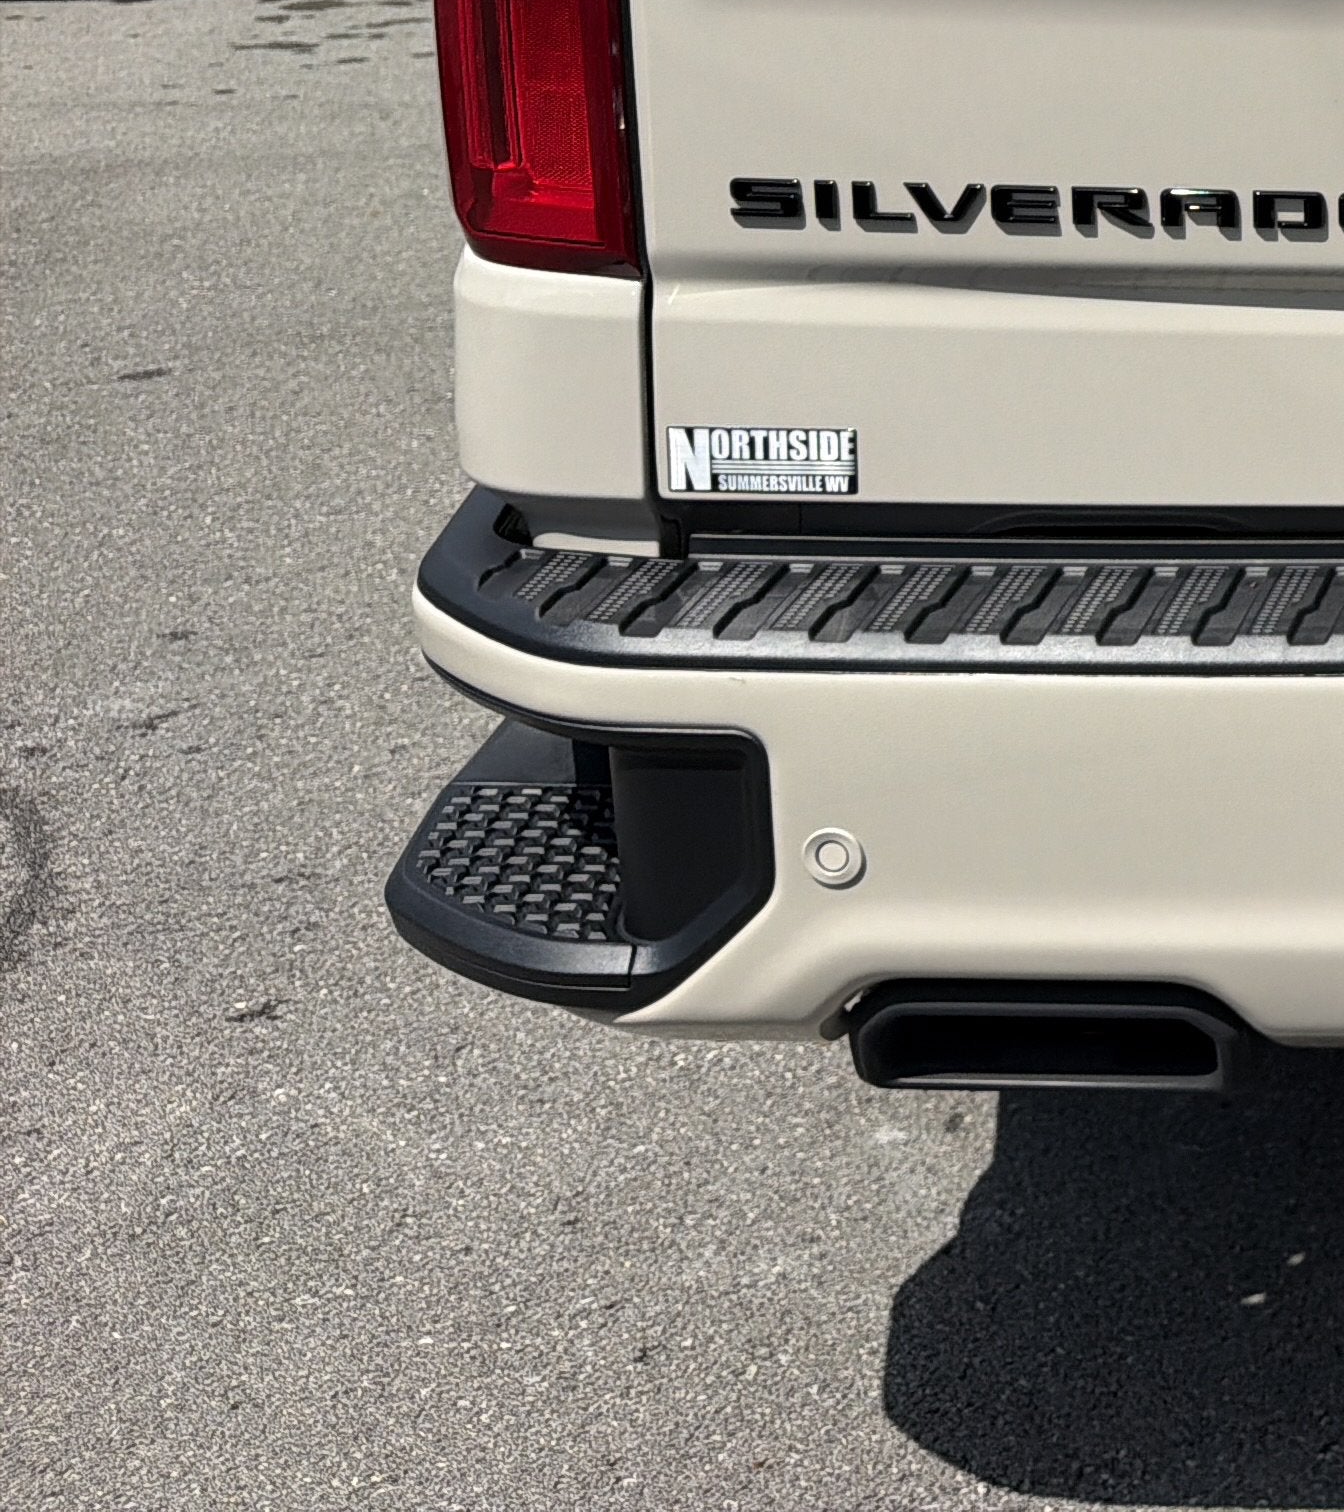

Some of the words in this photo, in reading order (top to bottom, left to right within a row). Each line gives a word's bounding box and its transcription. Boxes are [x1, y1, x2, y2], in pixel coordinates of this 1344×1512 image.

[668, 426, 855, 491] NORTHSIDE
[718, 474, 823, 492] SUMMERSVILLE
[825, 475, 849, 493] WV
